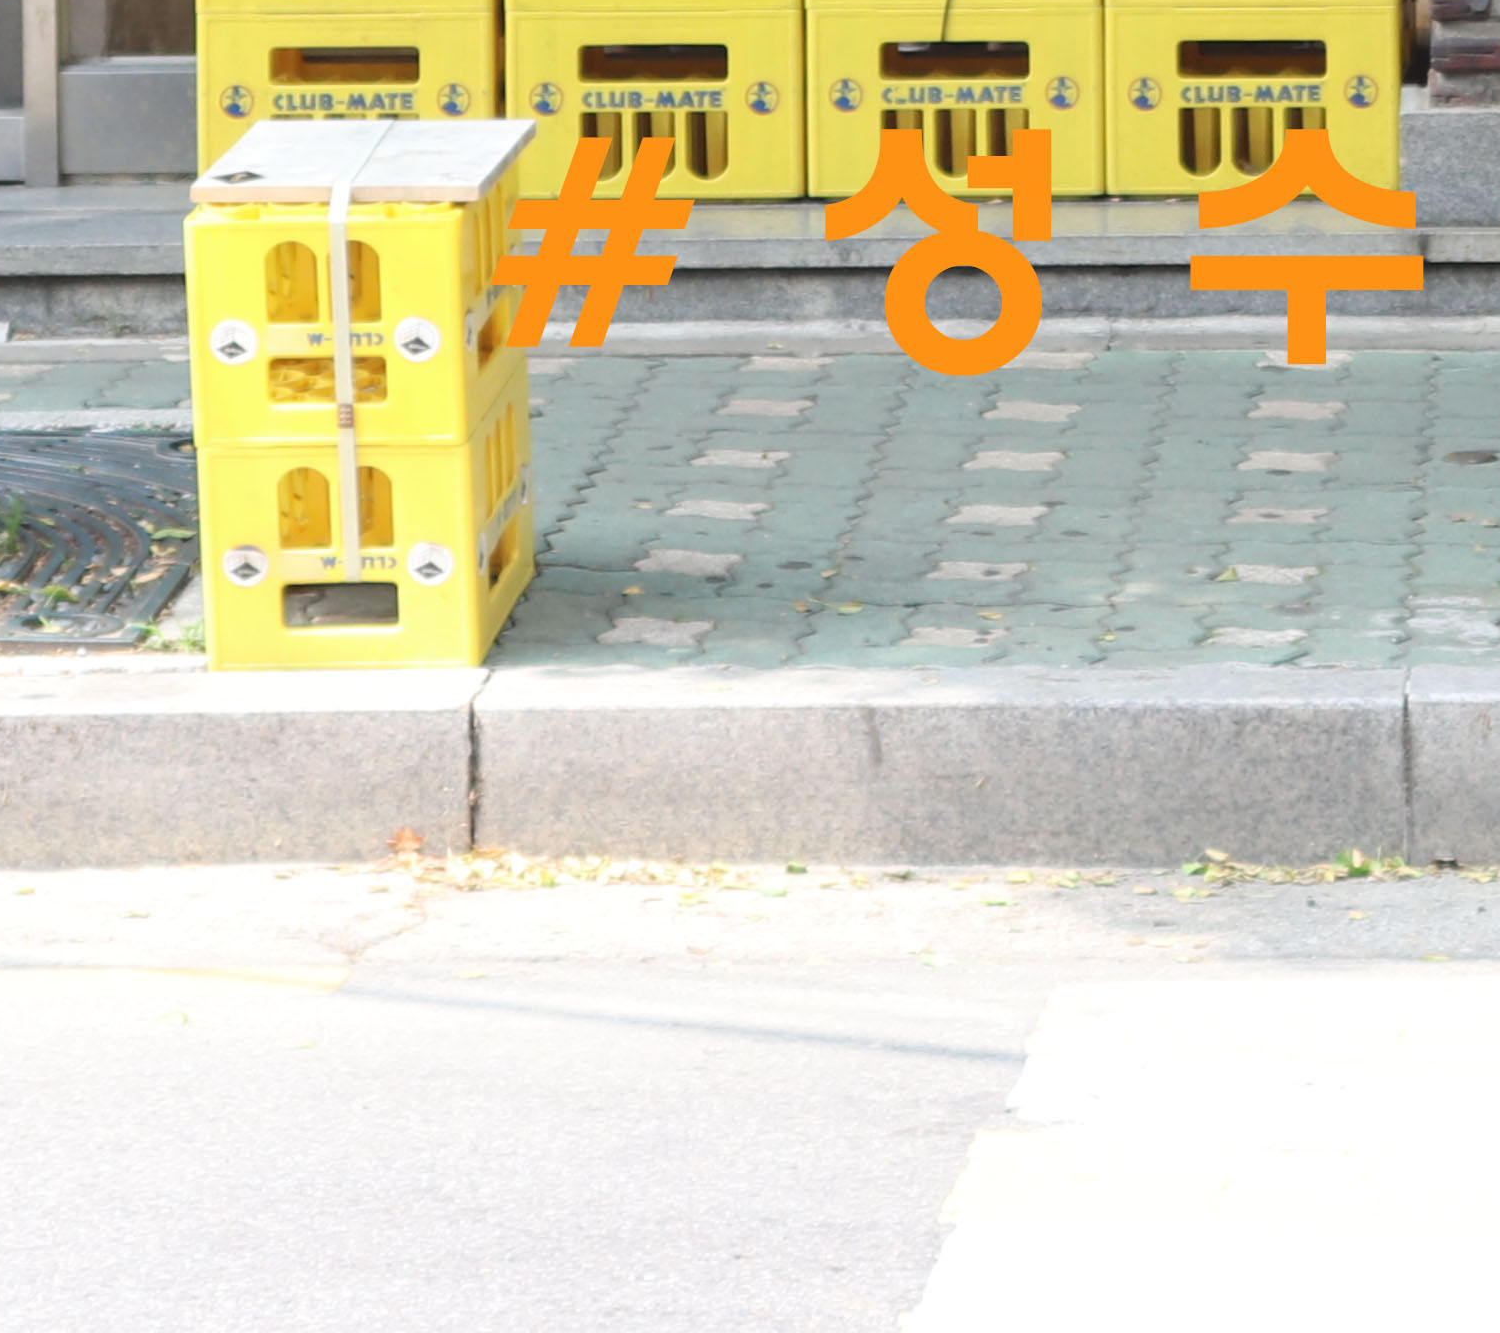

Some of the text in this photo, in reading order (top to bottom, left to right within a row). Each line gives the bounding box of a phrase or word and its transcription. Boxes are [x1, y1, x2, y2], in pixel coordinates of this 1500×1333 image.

[275, 92, 413, 110] CLUB-MATE
[584, 90, 722, 108] CLUB-MATE
[1182, 84, 1320, 102] CLUB-MATE
